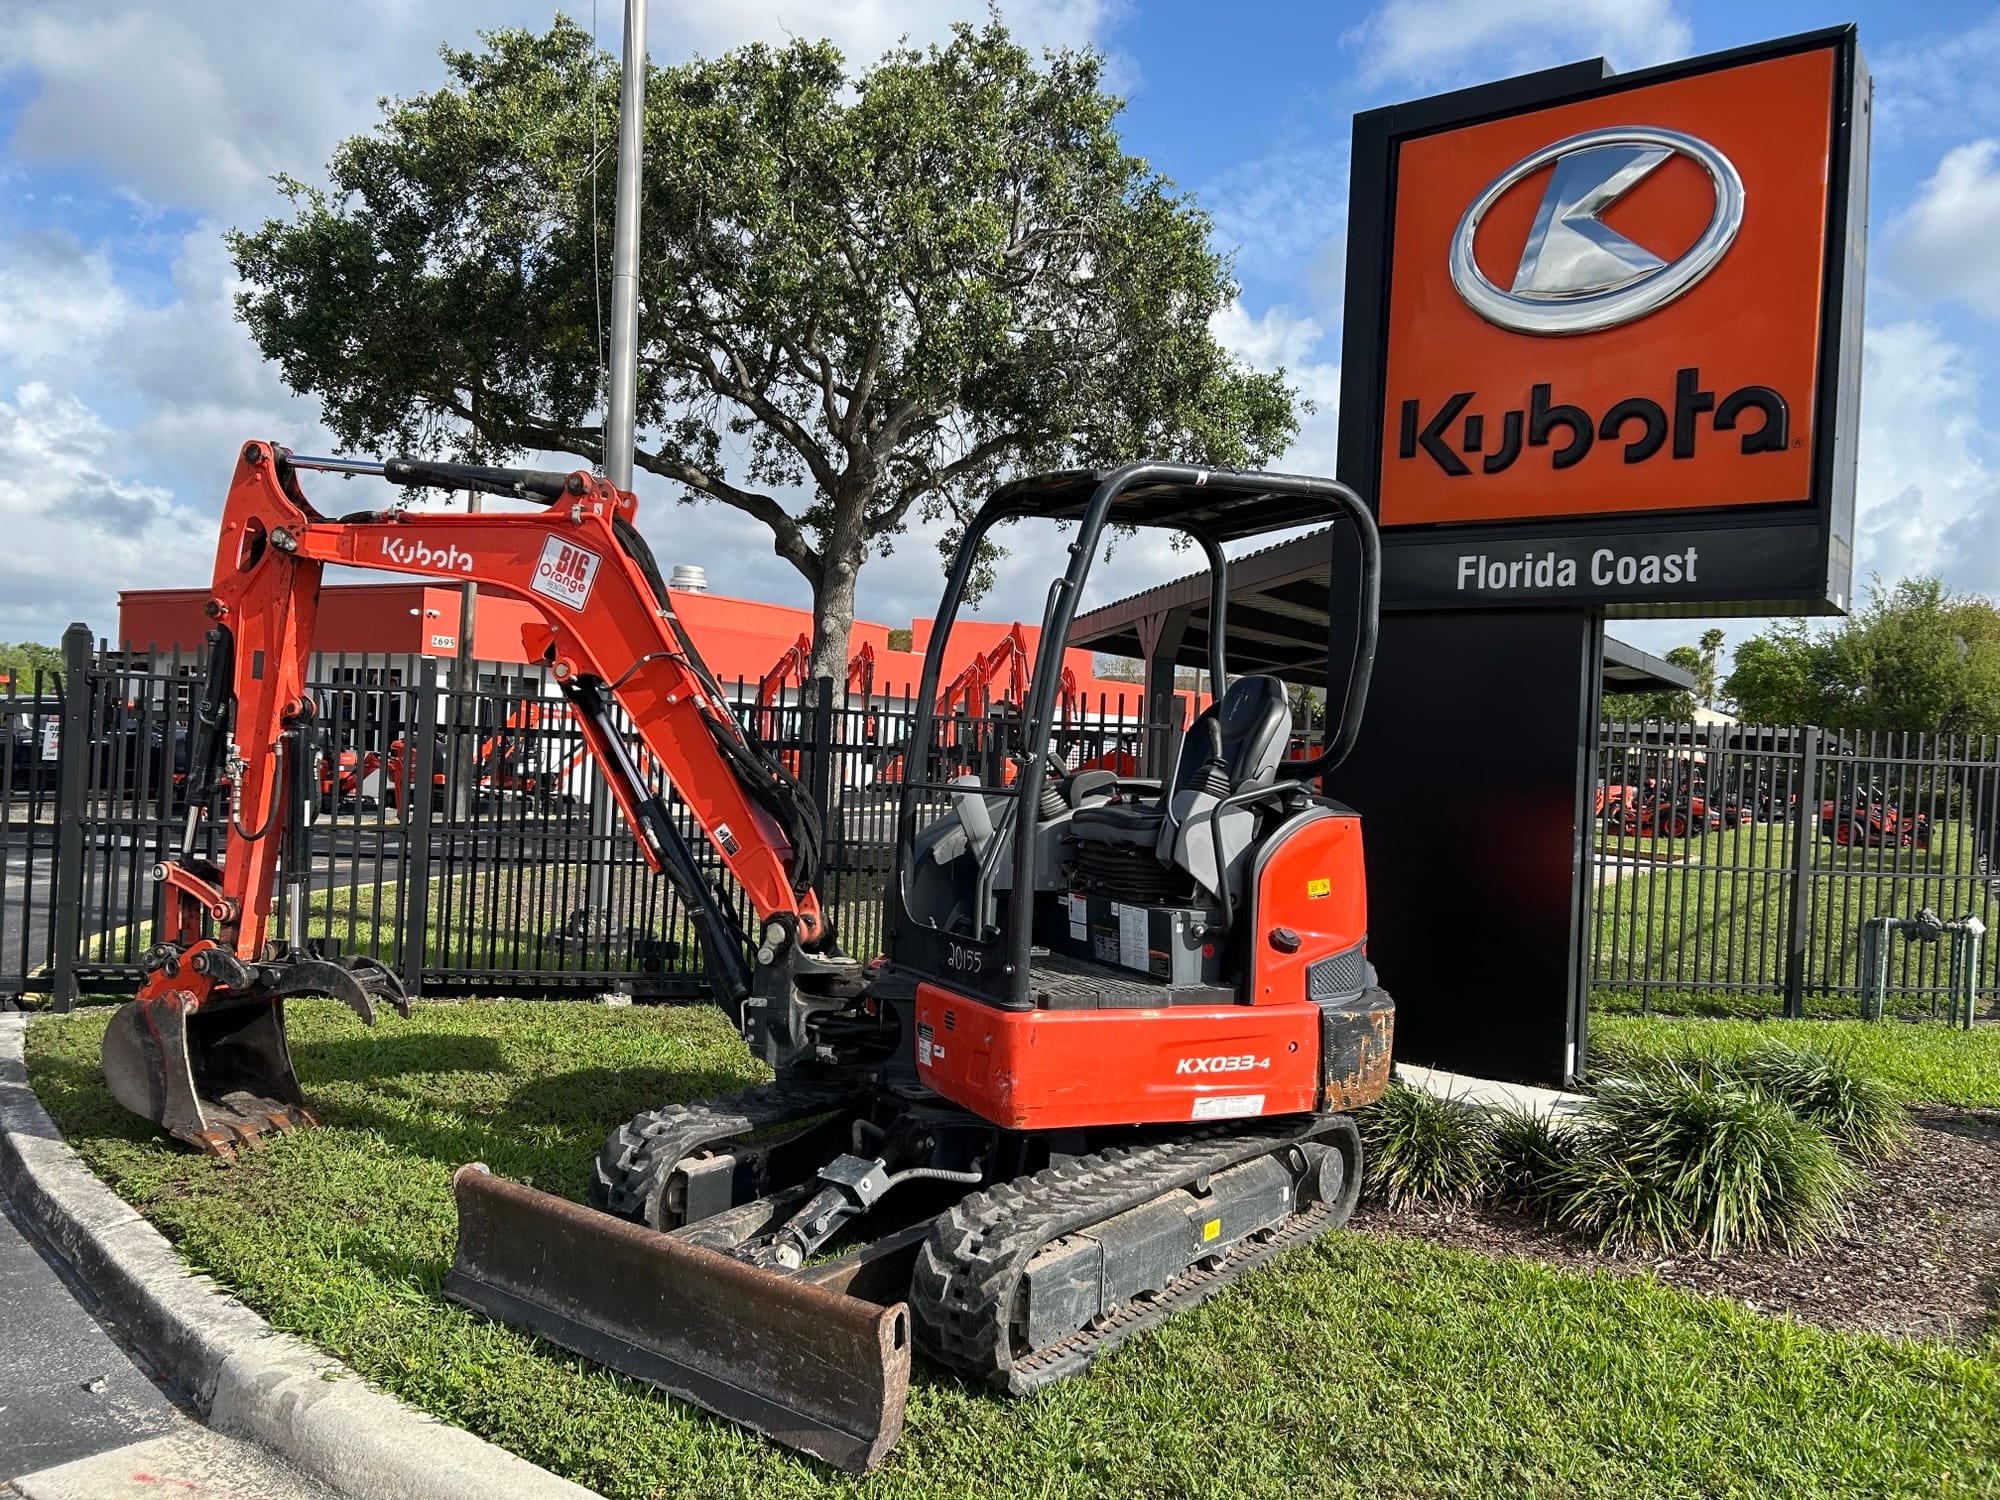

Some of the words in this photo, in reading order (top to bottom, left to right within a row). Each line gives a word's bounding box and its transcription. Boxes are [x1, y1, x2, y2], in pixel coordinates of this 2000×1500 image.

[1399, 367, 1789, 476] Kubota
[382, 536, 473, 572] Kubota
[556, 545, 590, 582] BIG
[1457, 552, 1576, 590] Florida
[1591, 547, 1698, 586] Coast
[540, 562, 586, 593] Orange
[432, 636, 455, 647] 2695
[948, 942, 982, 973] 20155
[1176, 1054, 1271, 1075] KX033-4
